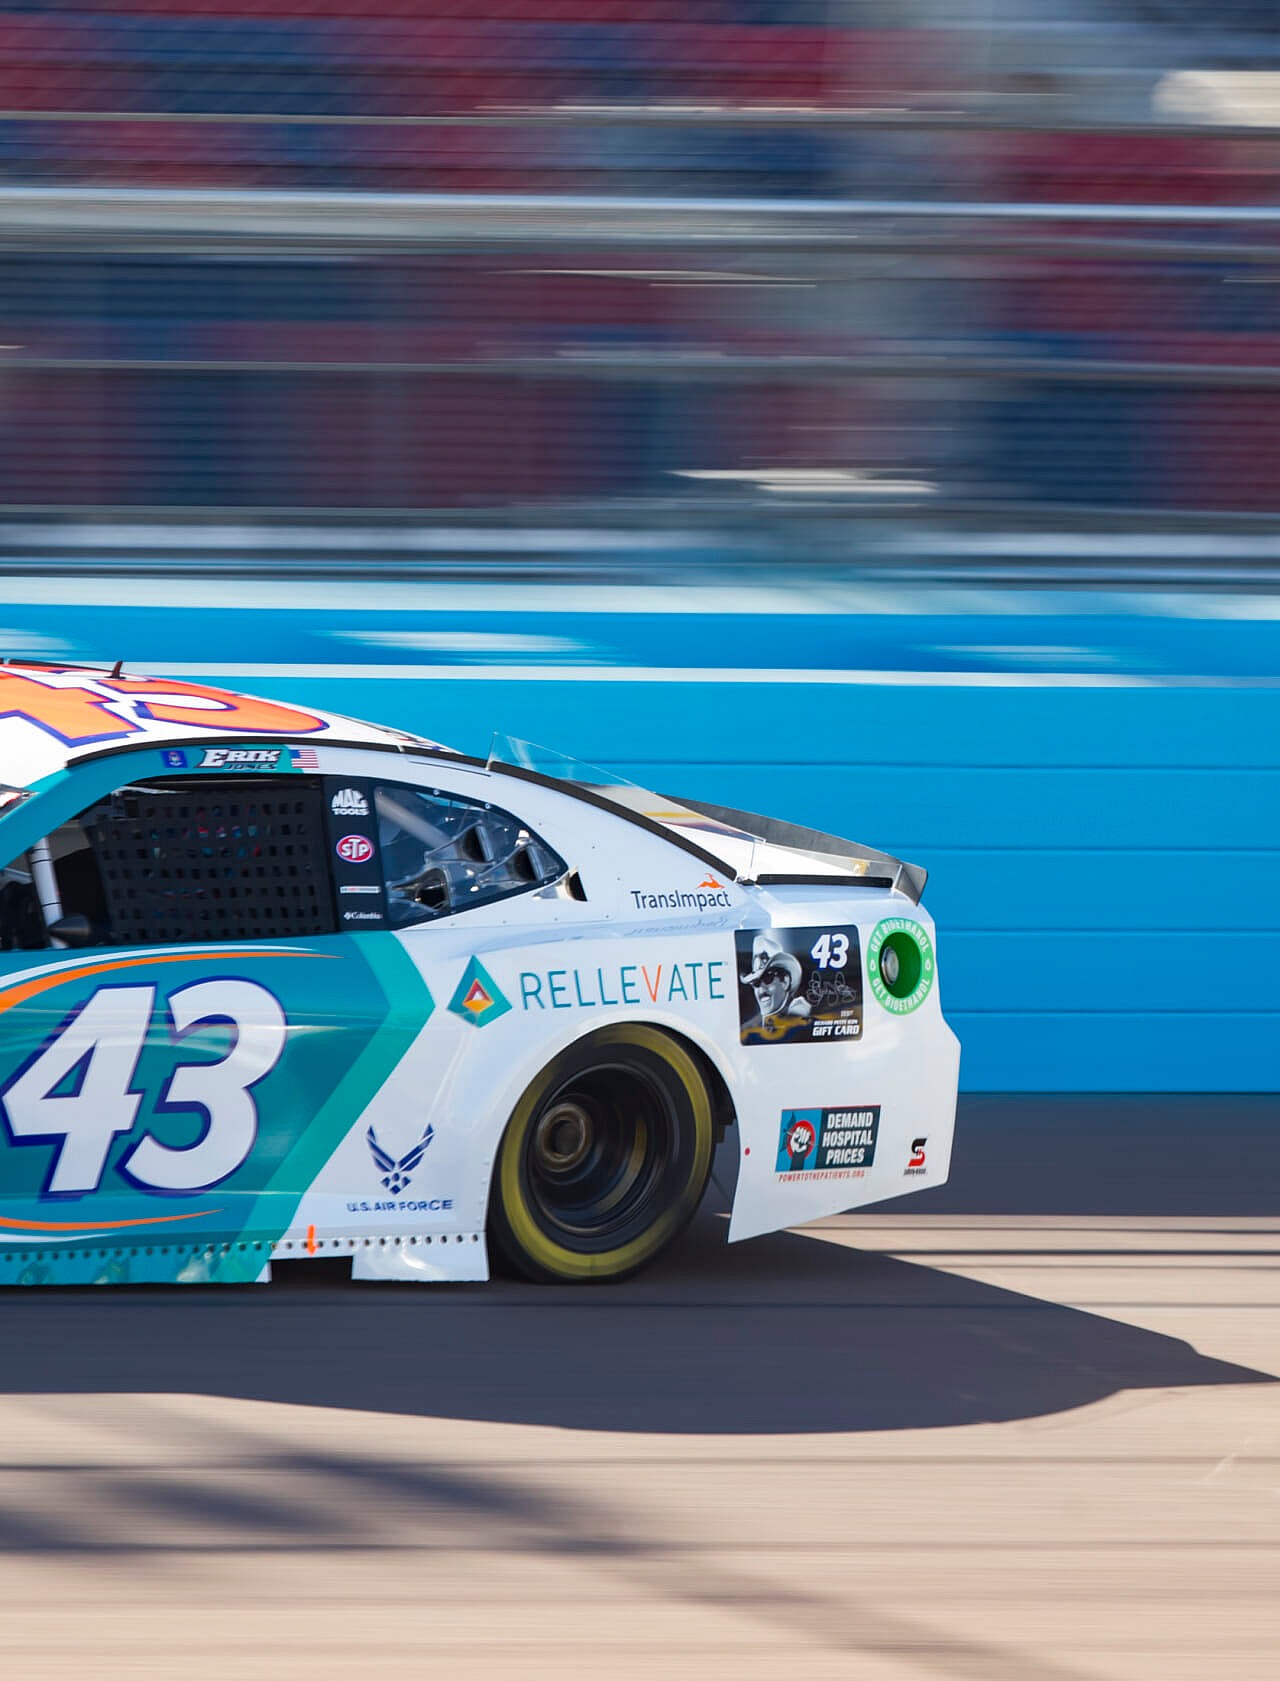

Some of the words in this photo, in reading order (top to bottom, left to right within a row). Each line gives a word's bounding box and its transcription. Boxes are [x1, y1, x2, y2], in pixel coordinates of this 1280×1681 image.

[197, 749, 282, 768] ERIK
[331, 788, 369, 808] MAC
[331, 808, 370, 816] TOOLS
[341, 838, 370, 859] STP
[630, 889, 732, 911] TransImpact
[810, 932, 850, 969] 43
[520, 961, 725, 1010] RELLEVATE
[812, 1026, 834, 1037] GIFT
[834, 1024, 860, 1036] CARD
[827, 1112, 874, 1130] DEMAND
[822, 1129, 873, 1148] HOSPITAL
[825, 1148, 865, 1166] PRICES
[778, 1170, 866, 1183] POWERTOTHEPATIENTS.ORG
[374, 1201, 396, 1211] AIR
[398, 1199, 454, 1211] FORCE
